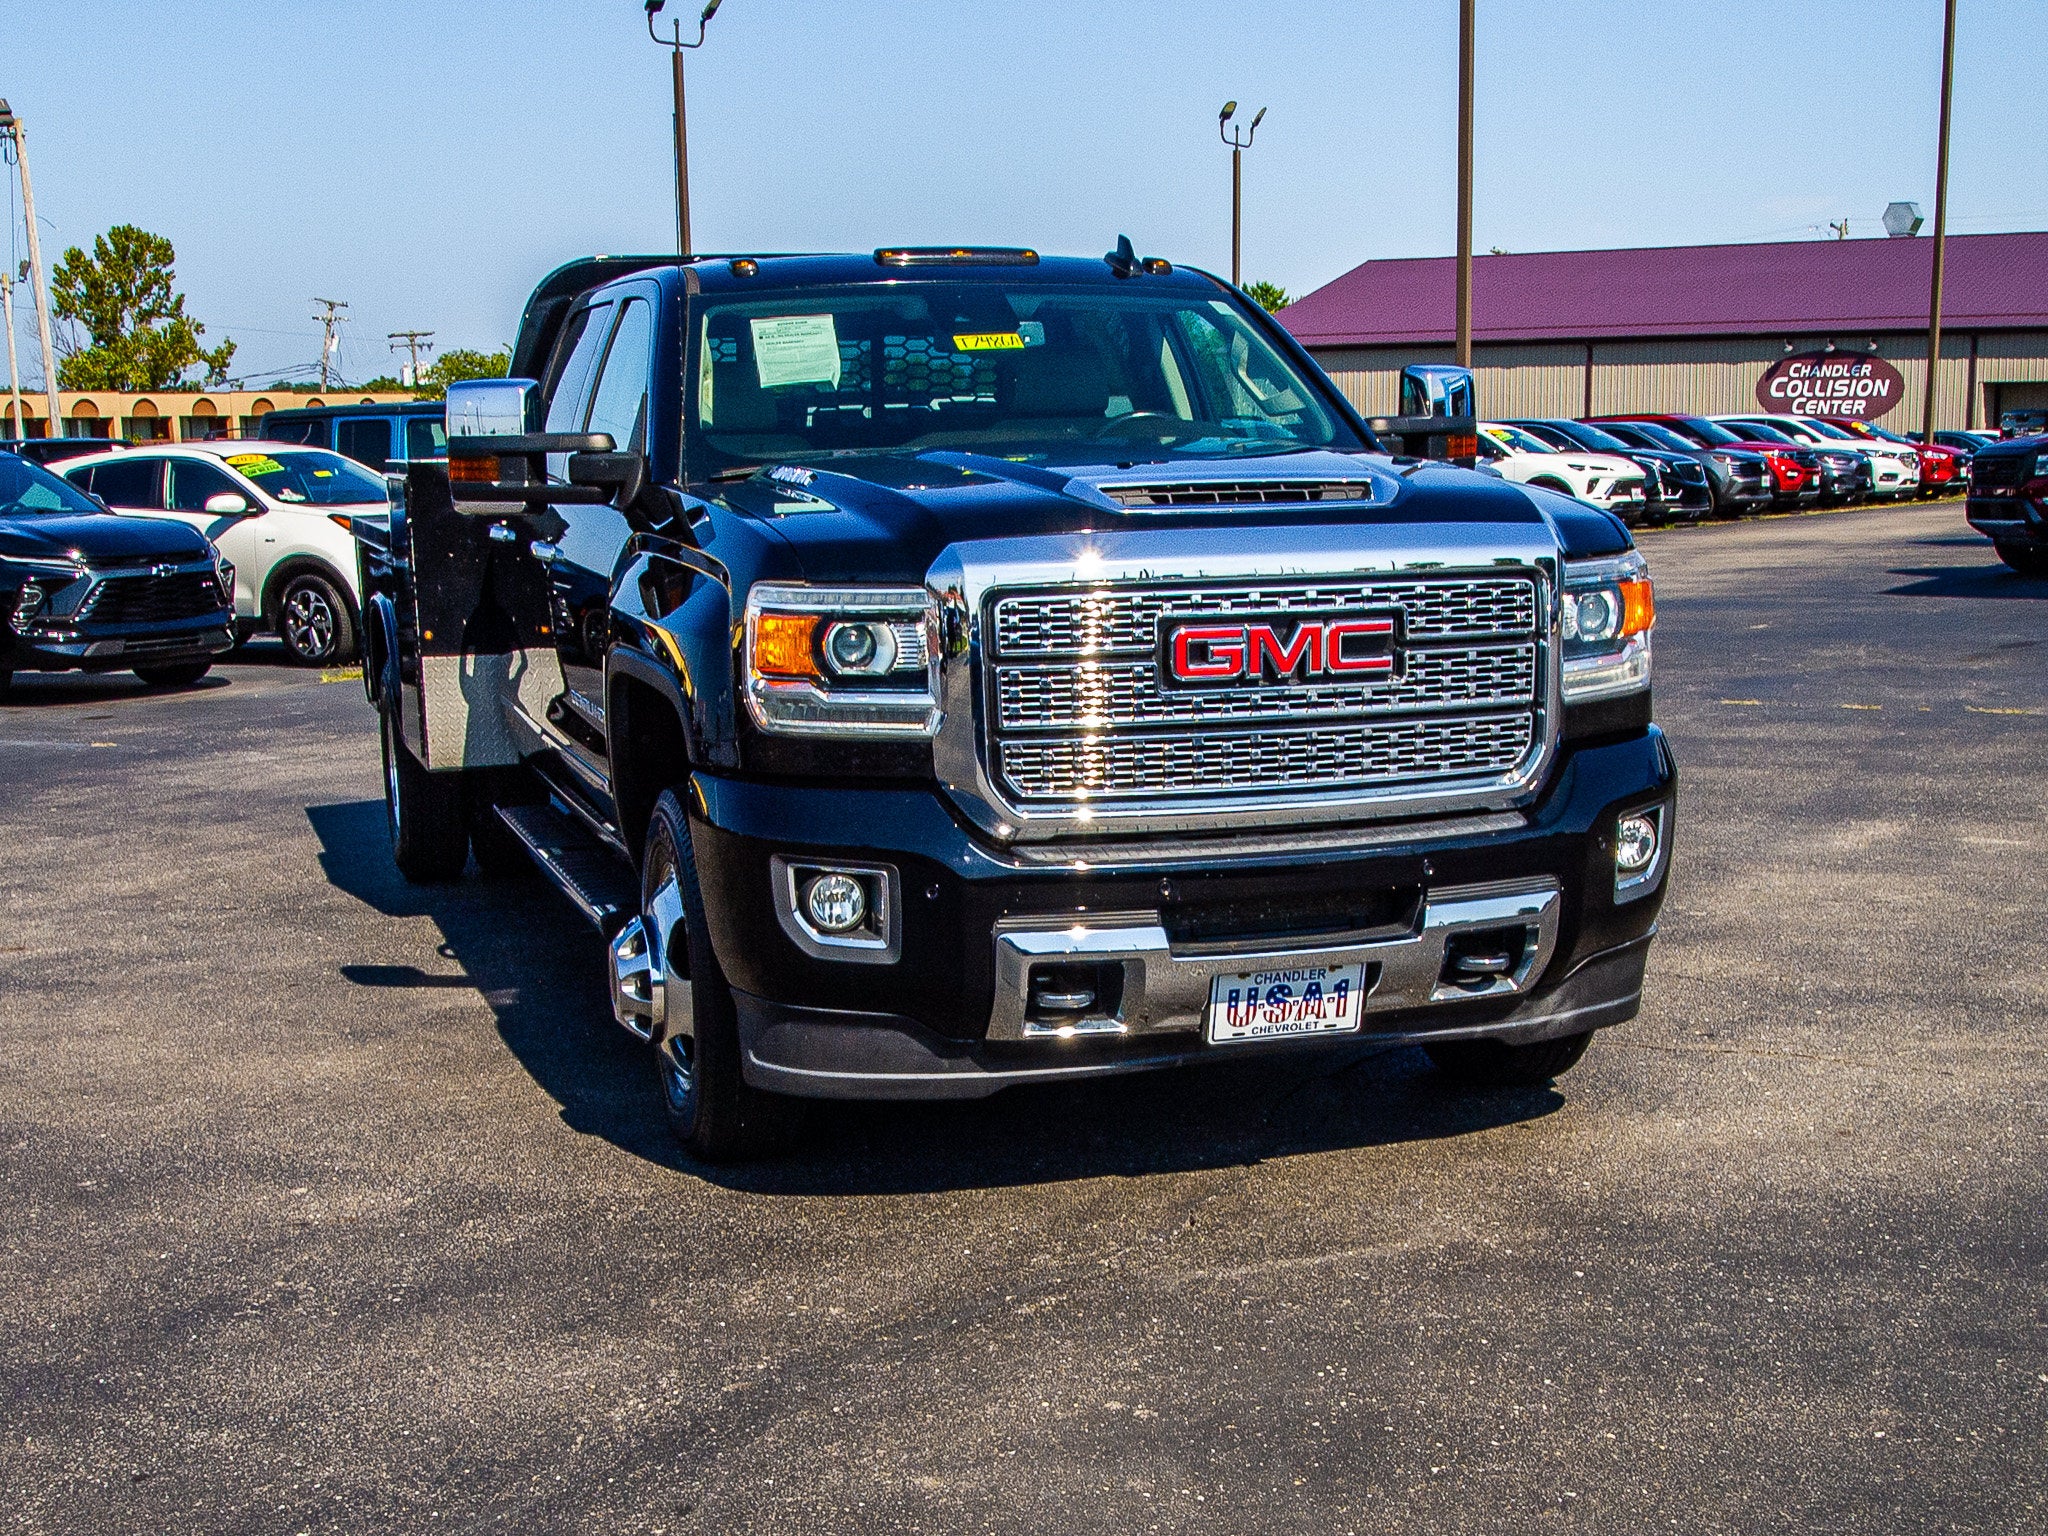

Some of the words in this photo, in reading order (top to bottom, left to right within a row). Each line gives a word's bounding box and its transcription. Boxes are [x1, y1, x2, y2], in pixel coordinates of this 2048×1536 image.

[1788, 362, 1872, 378] CHANDLER
[1769, 376, 1891, 398] COLLISION
[1791, 397, 1867, 415] CENTER
[1170, 617, 1394, 681] GMC
[1254, 968, 1327, 985] CHANDLER
[1251, 1020, 1320, 1036] CHEVROLET
